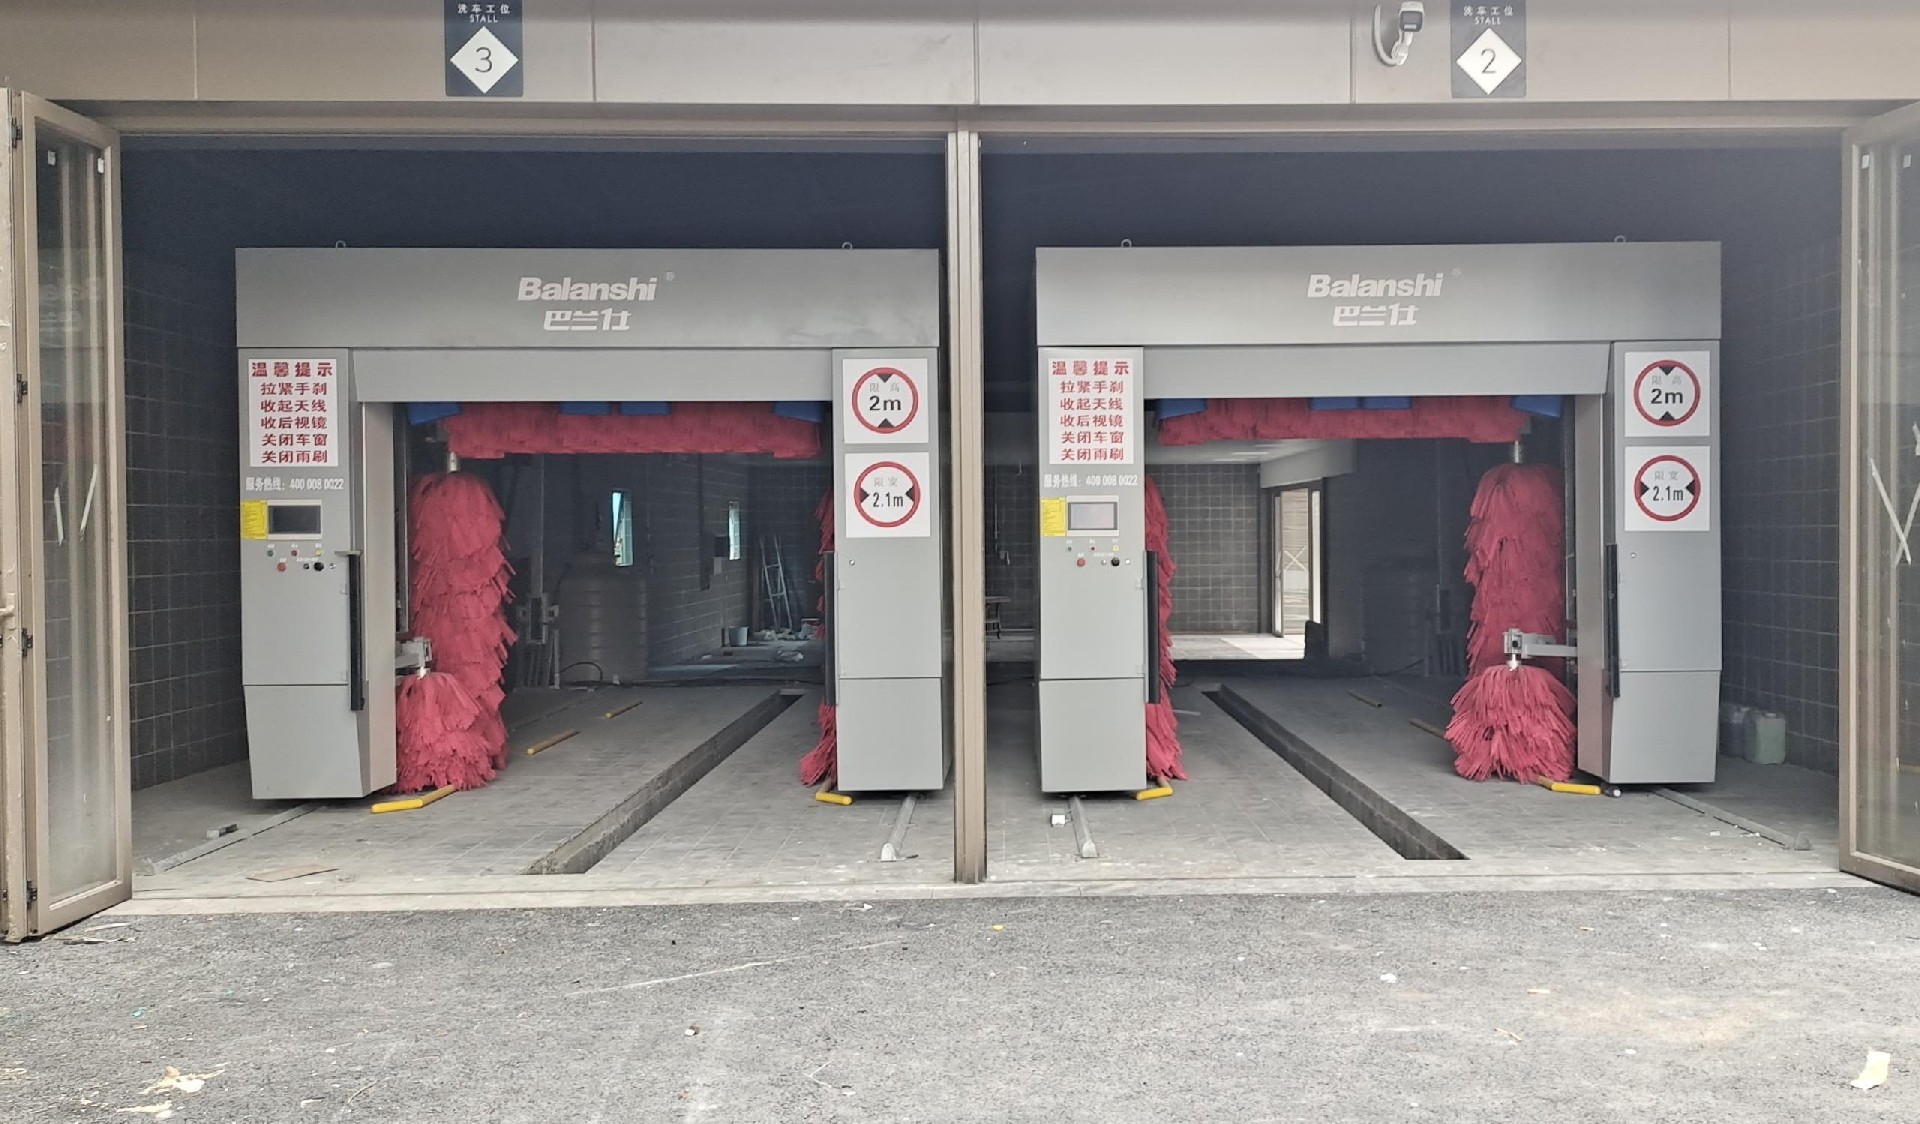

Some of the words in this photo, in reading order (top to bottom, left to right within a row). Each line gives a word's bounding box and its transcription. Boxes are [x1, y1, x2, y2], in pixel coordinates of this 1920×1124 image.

[457, 3, 510, 14] 洗车工位
[469, 14, 499, 23] STALL
[1474, 16, 1502, 25] STALL
[475, 46, 493, 73] 3
[1481, 48, 1497, 74] 2
[517, 276, 658, 302] Balanshi
[1307, 272, 1444, 298] Balanshi
[543, 307, 632, 331] 巴兰仕
[1333, 302, 1419, 327] 巴兰仕
[251, 361, 333, 378] 温馨提示
[1052, 360, 1129, 376] 温馨提示
[260, 382, 328, 396] 拉紧手刹
[1060, 380, 1124, 393] 拉紧手刹
[869, 395, 902, 411] 2m
[1650, 388, 1683, 404] 2m
[260, 399, 327, 413] 收起天线
[1060, 397, 1123, 411] 收起天线
[260, 416, 328, 430] 收后视镜
[1060, 413, 1123, 428] 收后视镜
[261, 433, 328, 447] 关闭车窗
[1061, 431, 1124, 444] 关闭车窗
[261, 449, 328, 464] 关闭雨刷
[1060, 447, 1124, 461] 关闭雨刷
[289, 478, 305, 490] 400
[324, 478, 344, 490] 0022
[1085, 474, 1101, 487] 400
[1118, 474, 1138, 487] 0022
[872, 492, 903, 508] 2.1m
[1652, 485, 1683, 501] 2.1m
